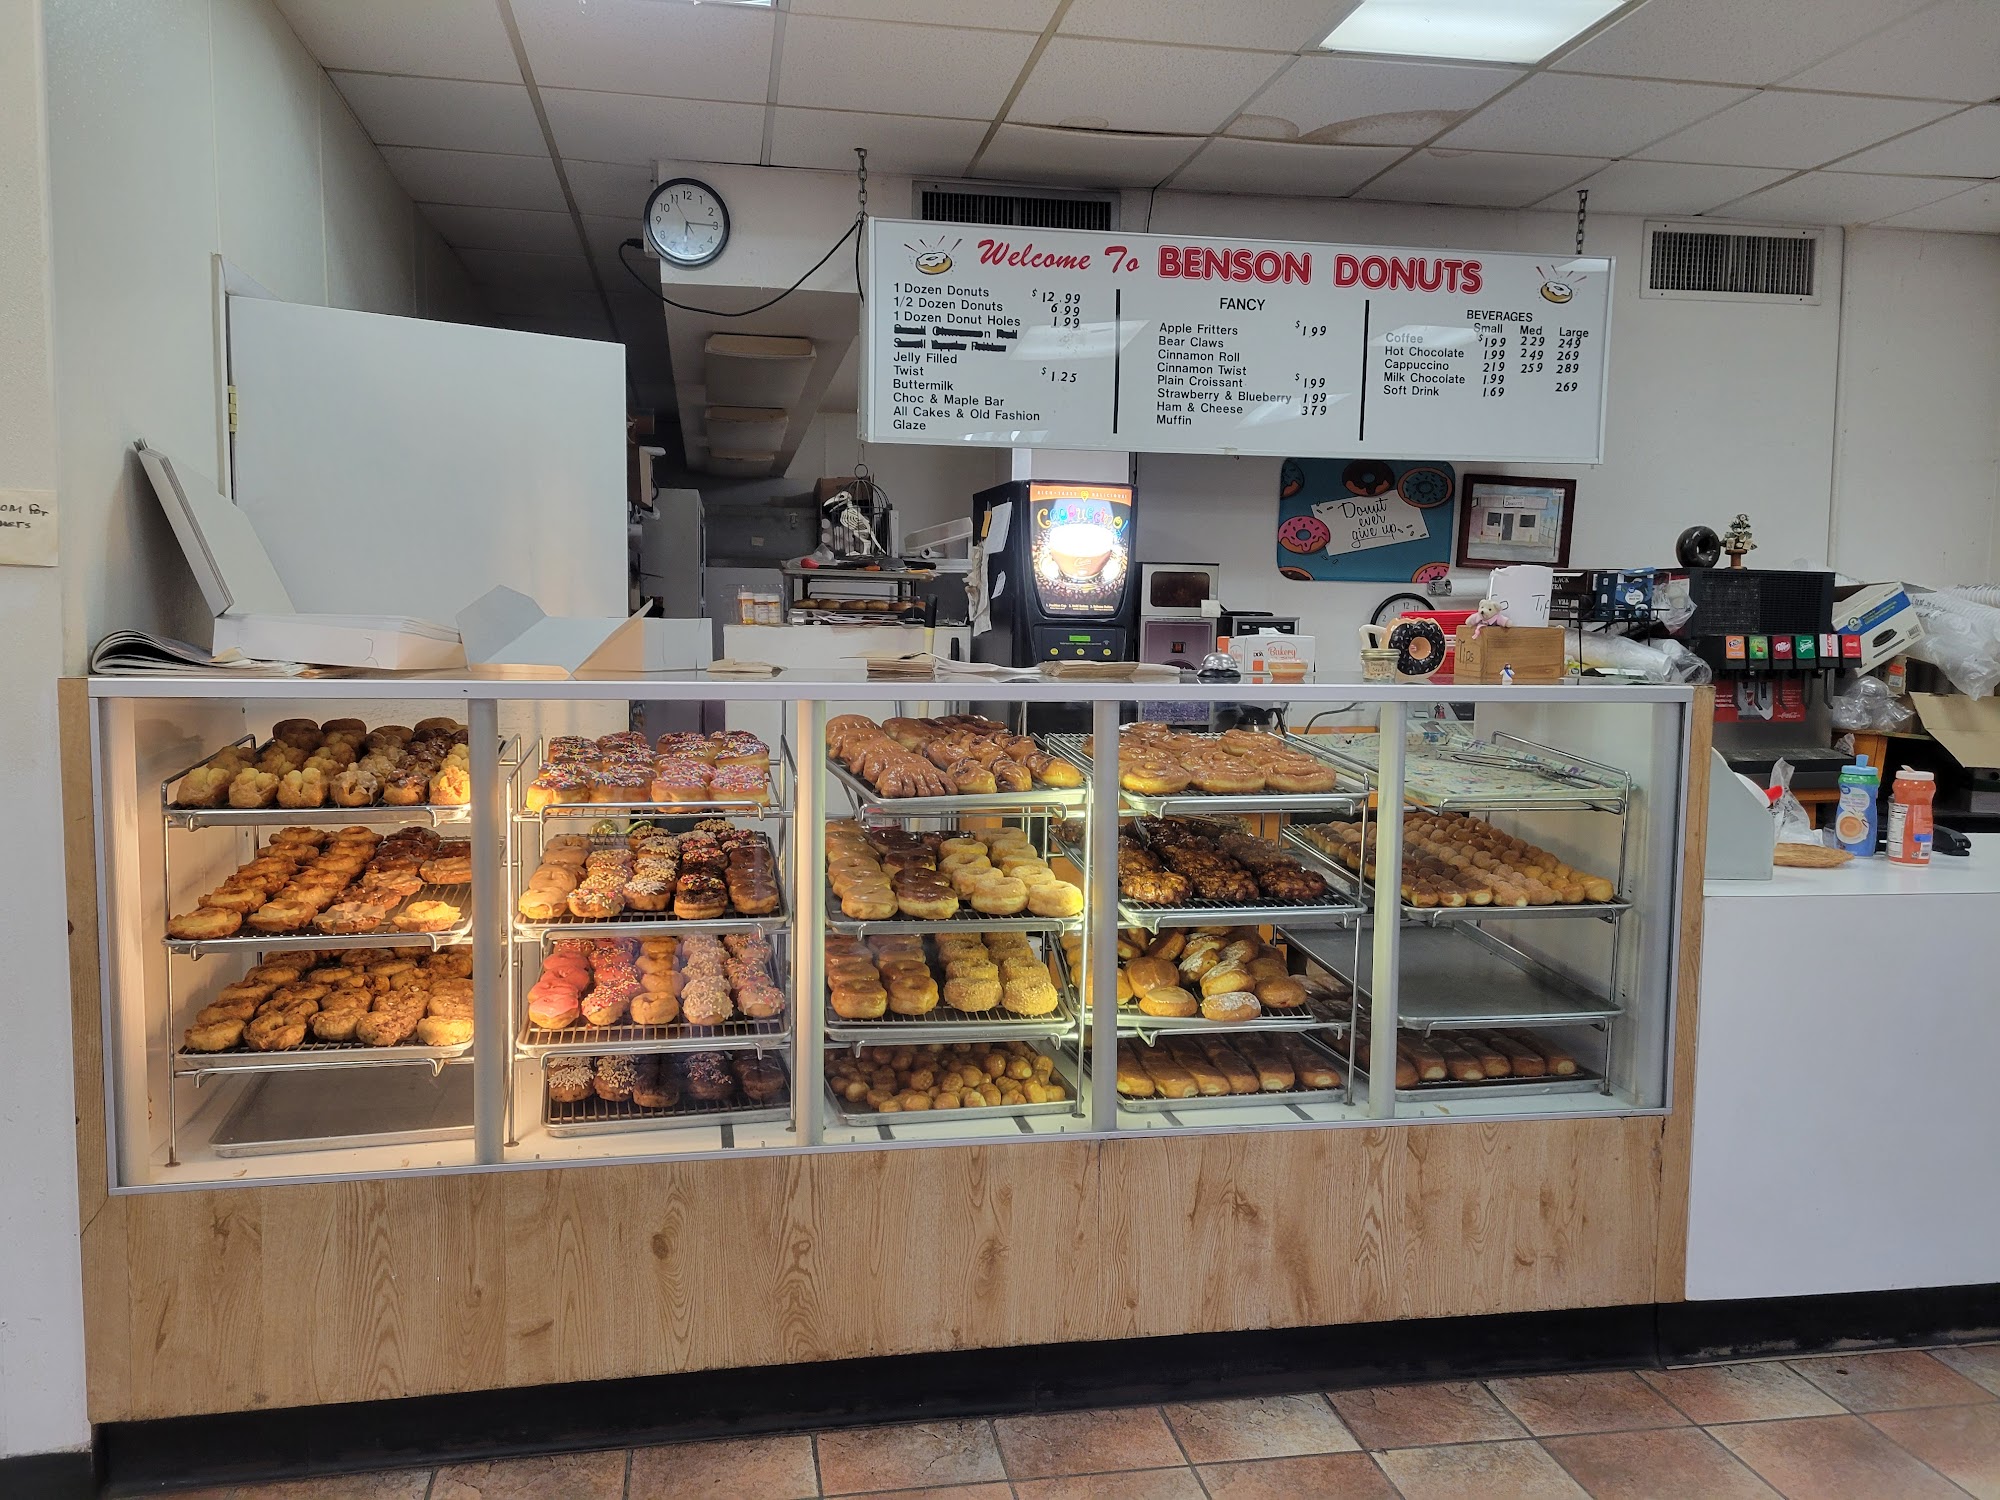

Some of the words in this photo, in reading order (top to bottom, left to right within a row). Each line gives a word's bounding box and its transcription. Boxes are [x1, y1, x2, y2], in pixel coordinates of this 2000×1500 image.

[670, 194, 679, 203] 11
[683, 191, 692, 200] 12
[699, 196, 702, 204] 1
[660, 203, 670, 212] 10
[708, 207, 714, 216] 2
[656, 216, 661, 224] 9
[707, 236, 713, 244] 4
[977, 239, 1091, 270] Welcome
[1104, 246, 1140, 273] To
[1158, 245, 1312, 285] BENSON
[1333, 253, 1483, 294] DONUTS
[893, 283, 899, 293] 1
[904, 283, 942, 295] Dozen
[947, 285, 989, 297] Donuts
[893, 296, 913, 307] 1/2
[918, 298, 956, 309] Dozen
[961, 299, 1003, 312] Donuts
[1219, 297, 1265, 311] FANCY
[893, 311, 899, 321] 1
[904, 312, 941, 323] Dozen
[947, 313, 982, 324] Donut
[988, 315, 1021, 326] Holes
[1467, 310, 1533, 322] BEVERAGES
[1160, 322, 1192, 334] Apple
[1197, 324, 1238, 336] Fritters
[1474, 323, 1503, 334] Small
[1520, 325, 1543, 336] Med
[1559, 326, 1589, 340] Large
[1158, 336, 1185, 346] Bear
[1190, 337, 1224, 348] Claws
[1386, 332, 1423, 343] Coffee
[893, 352, 921, 365] Jelly
[926, 353, 957, 364] Filled
[1158, 349, 1214, 361] Cinnamon
[1219, 352, 1240, 362] Roll
[1385, 346, 1404, 356] Hot
[1409, 346, 1464, 358] Chocolate
[893, 365, 924, 376] Twist
[1157, 362, 1213, 374] Cinnamon
[1218, 365, 1247, 376] Twist
[1384, 359, 1449, 371] Cappuccino
[893, 379, 954, 390] Buttermilk
[1157, 375, 1184, 386] Plain
[1189, 376, 1243, 388] Croissant
[1384, 372, 1405, 382] Milk
[1410, 372, 1465, 384] Chocolate
[1157, 388, 1219, 401] Strawberry
[1225, 391, 1232, 401] &
[1238, 392, 1292, 404] Blueberry
[1383, 385, 1406, 395] Soft
[1412, 386, 1440, 396] Drink
[893, 392, 924, 403] Choc
[930, 394, 938, 404] &
[944, 394, 979, 407] Maple
[984, 396, 1004, 406] Bar
[893, 406, 908, 416] All
[913, 407, 950, 418] Cakes
[956, 409, 964, 418] &
[970, 409, 989, 419] Old
[995, 410, 1040, 421] Fashion
[1156, 401, 1182, 412] Ham
[1187, 403, 1195, 412] &
[1201, 403, 1243, 414] Cheese
[893, 420, 926, 430] Glaze
[1156, 415, 1192, 425] Muffin
[1338, 498, 1388, 518] Donut
[1359, 513, 1386, 527] ever
[1351, 527, 1377, 548] give
[1403, 602, 1410, 610] 12
[1268, 645, 1296, 658] Bakery
[1459, 638, 1474, 665] Tips
